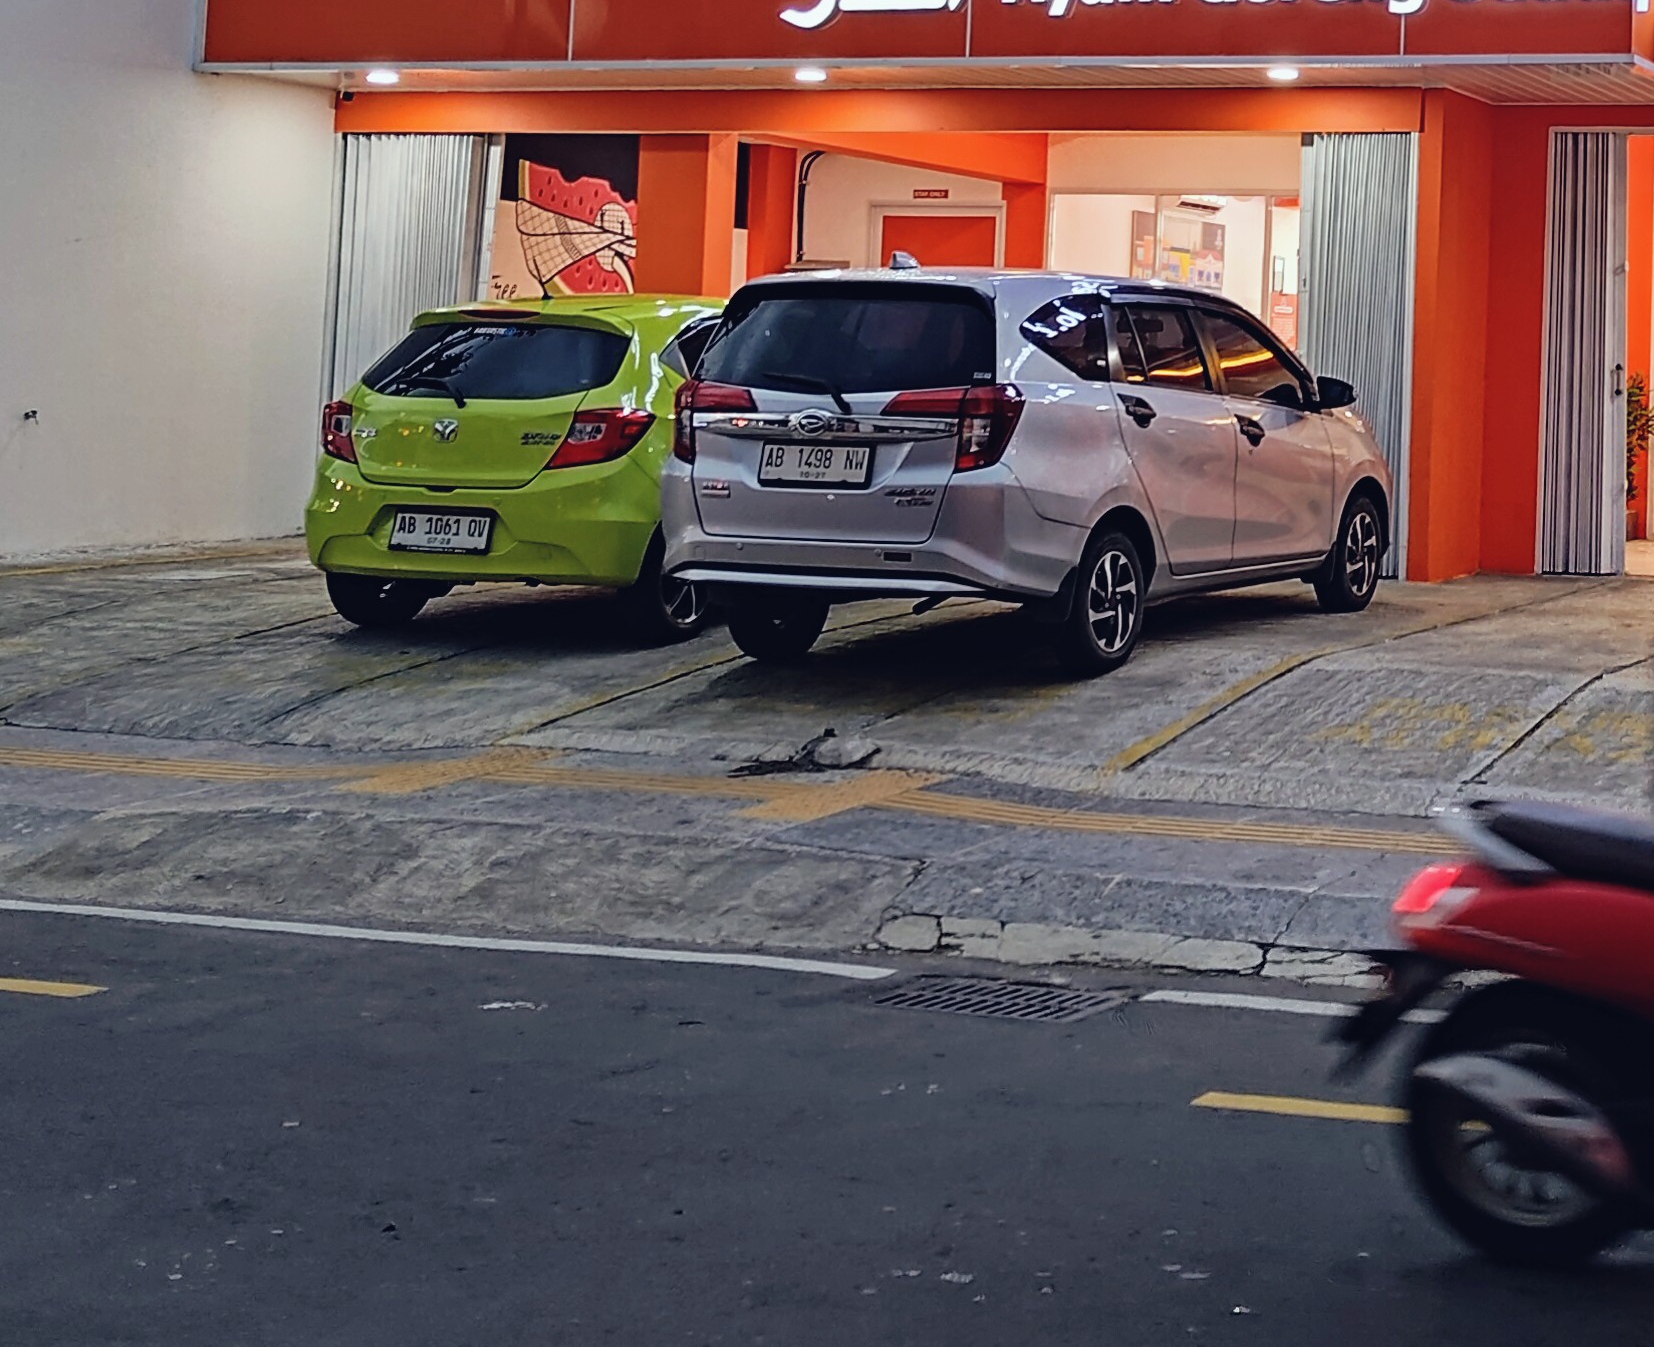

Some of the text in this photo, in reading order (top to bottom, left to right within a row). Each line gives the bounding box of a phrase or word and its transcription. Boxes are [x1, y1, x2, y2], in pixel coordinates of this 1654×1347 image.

[765, 447, 866, 470] AB 1498 NW
[397, 515, 487, 537] AB 1061 QV
